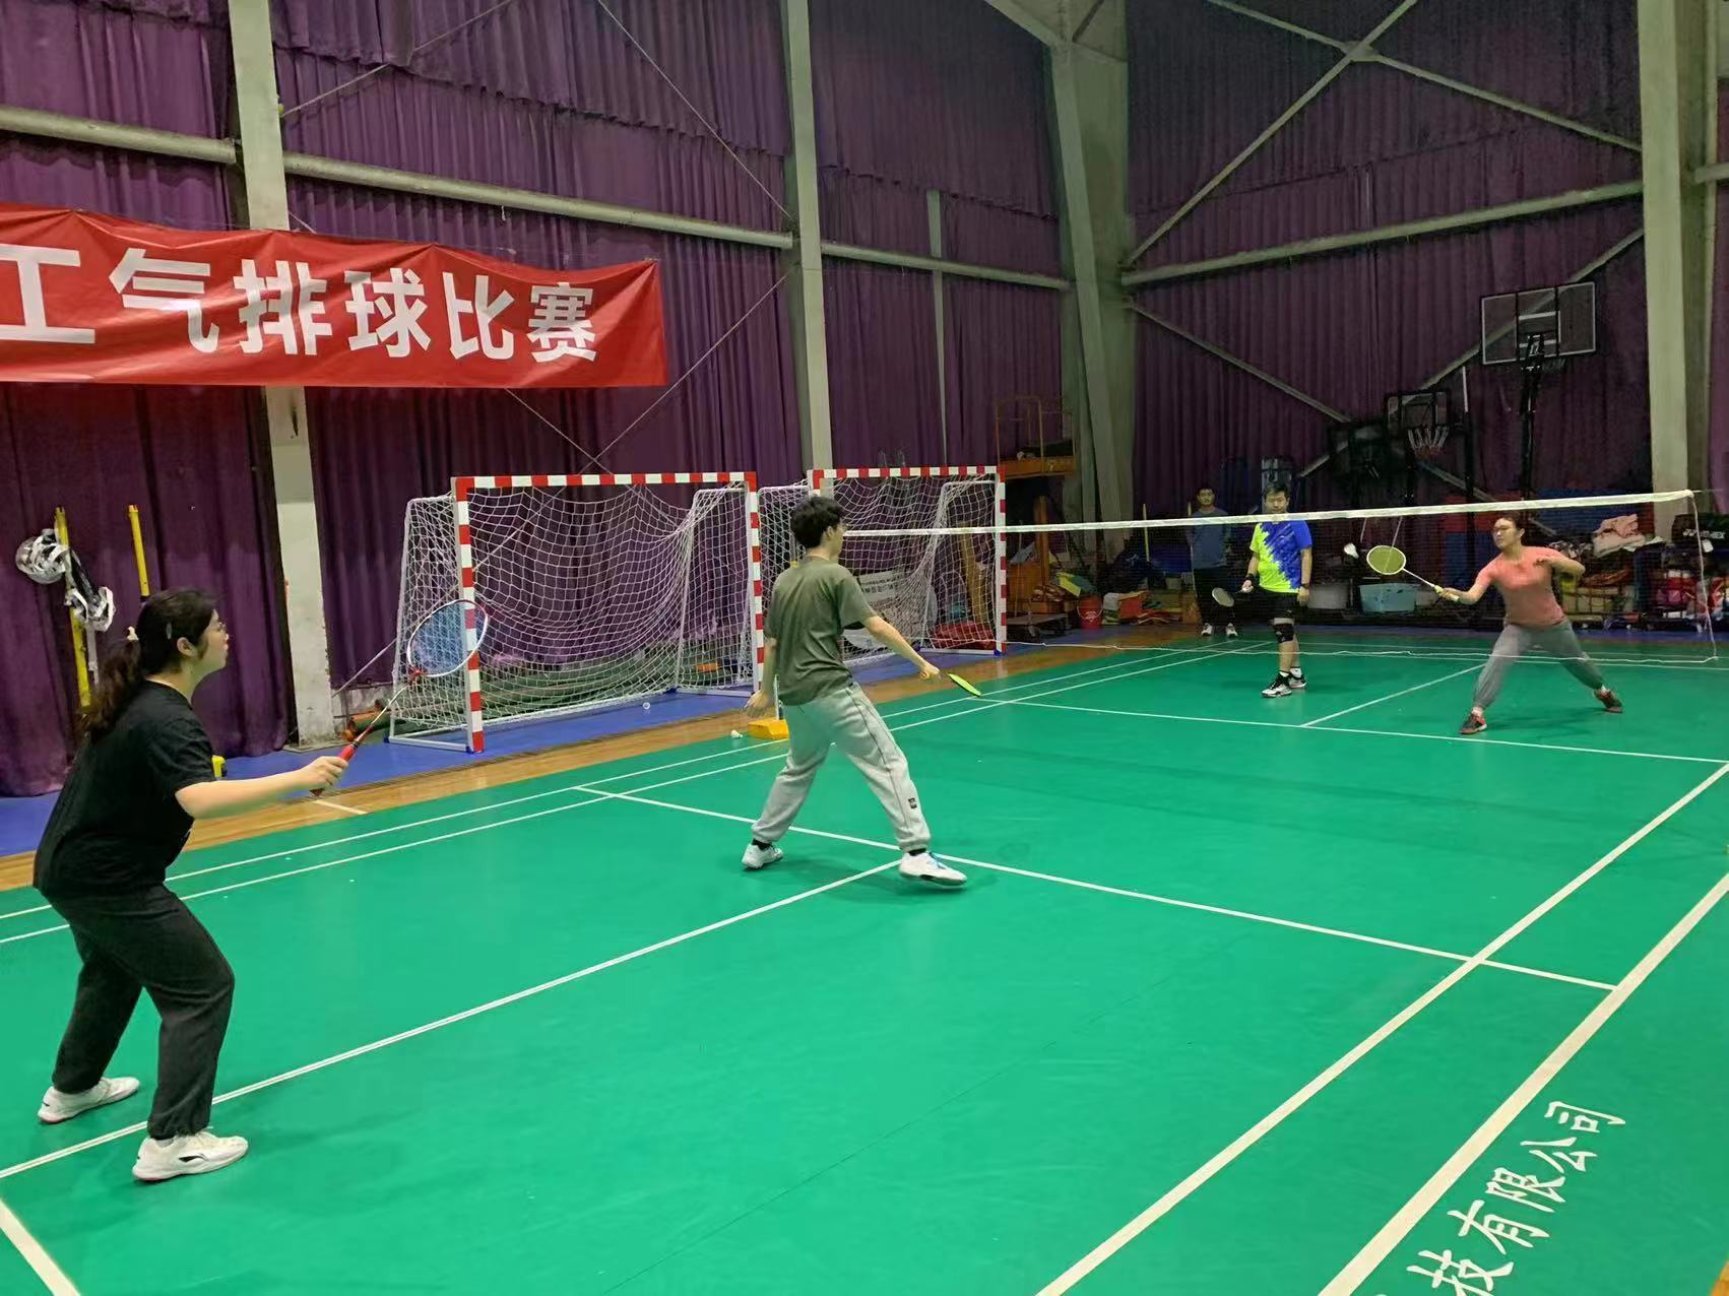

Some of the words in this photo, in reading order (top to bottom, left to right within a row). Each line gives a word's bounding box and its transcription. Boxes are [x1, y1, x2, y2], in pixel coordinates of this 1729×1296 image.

[0, 243, 597, 362] 工气排球比赛
